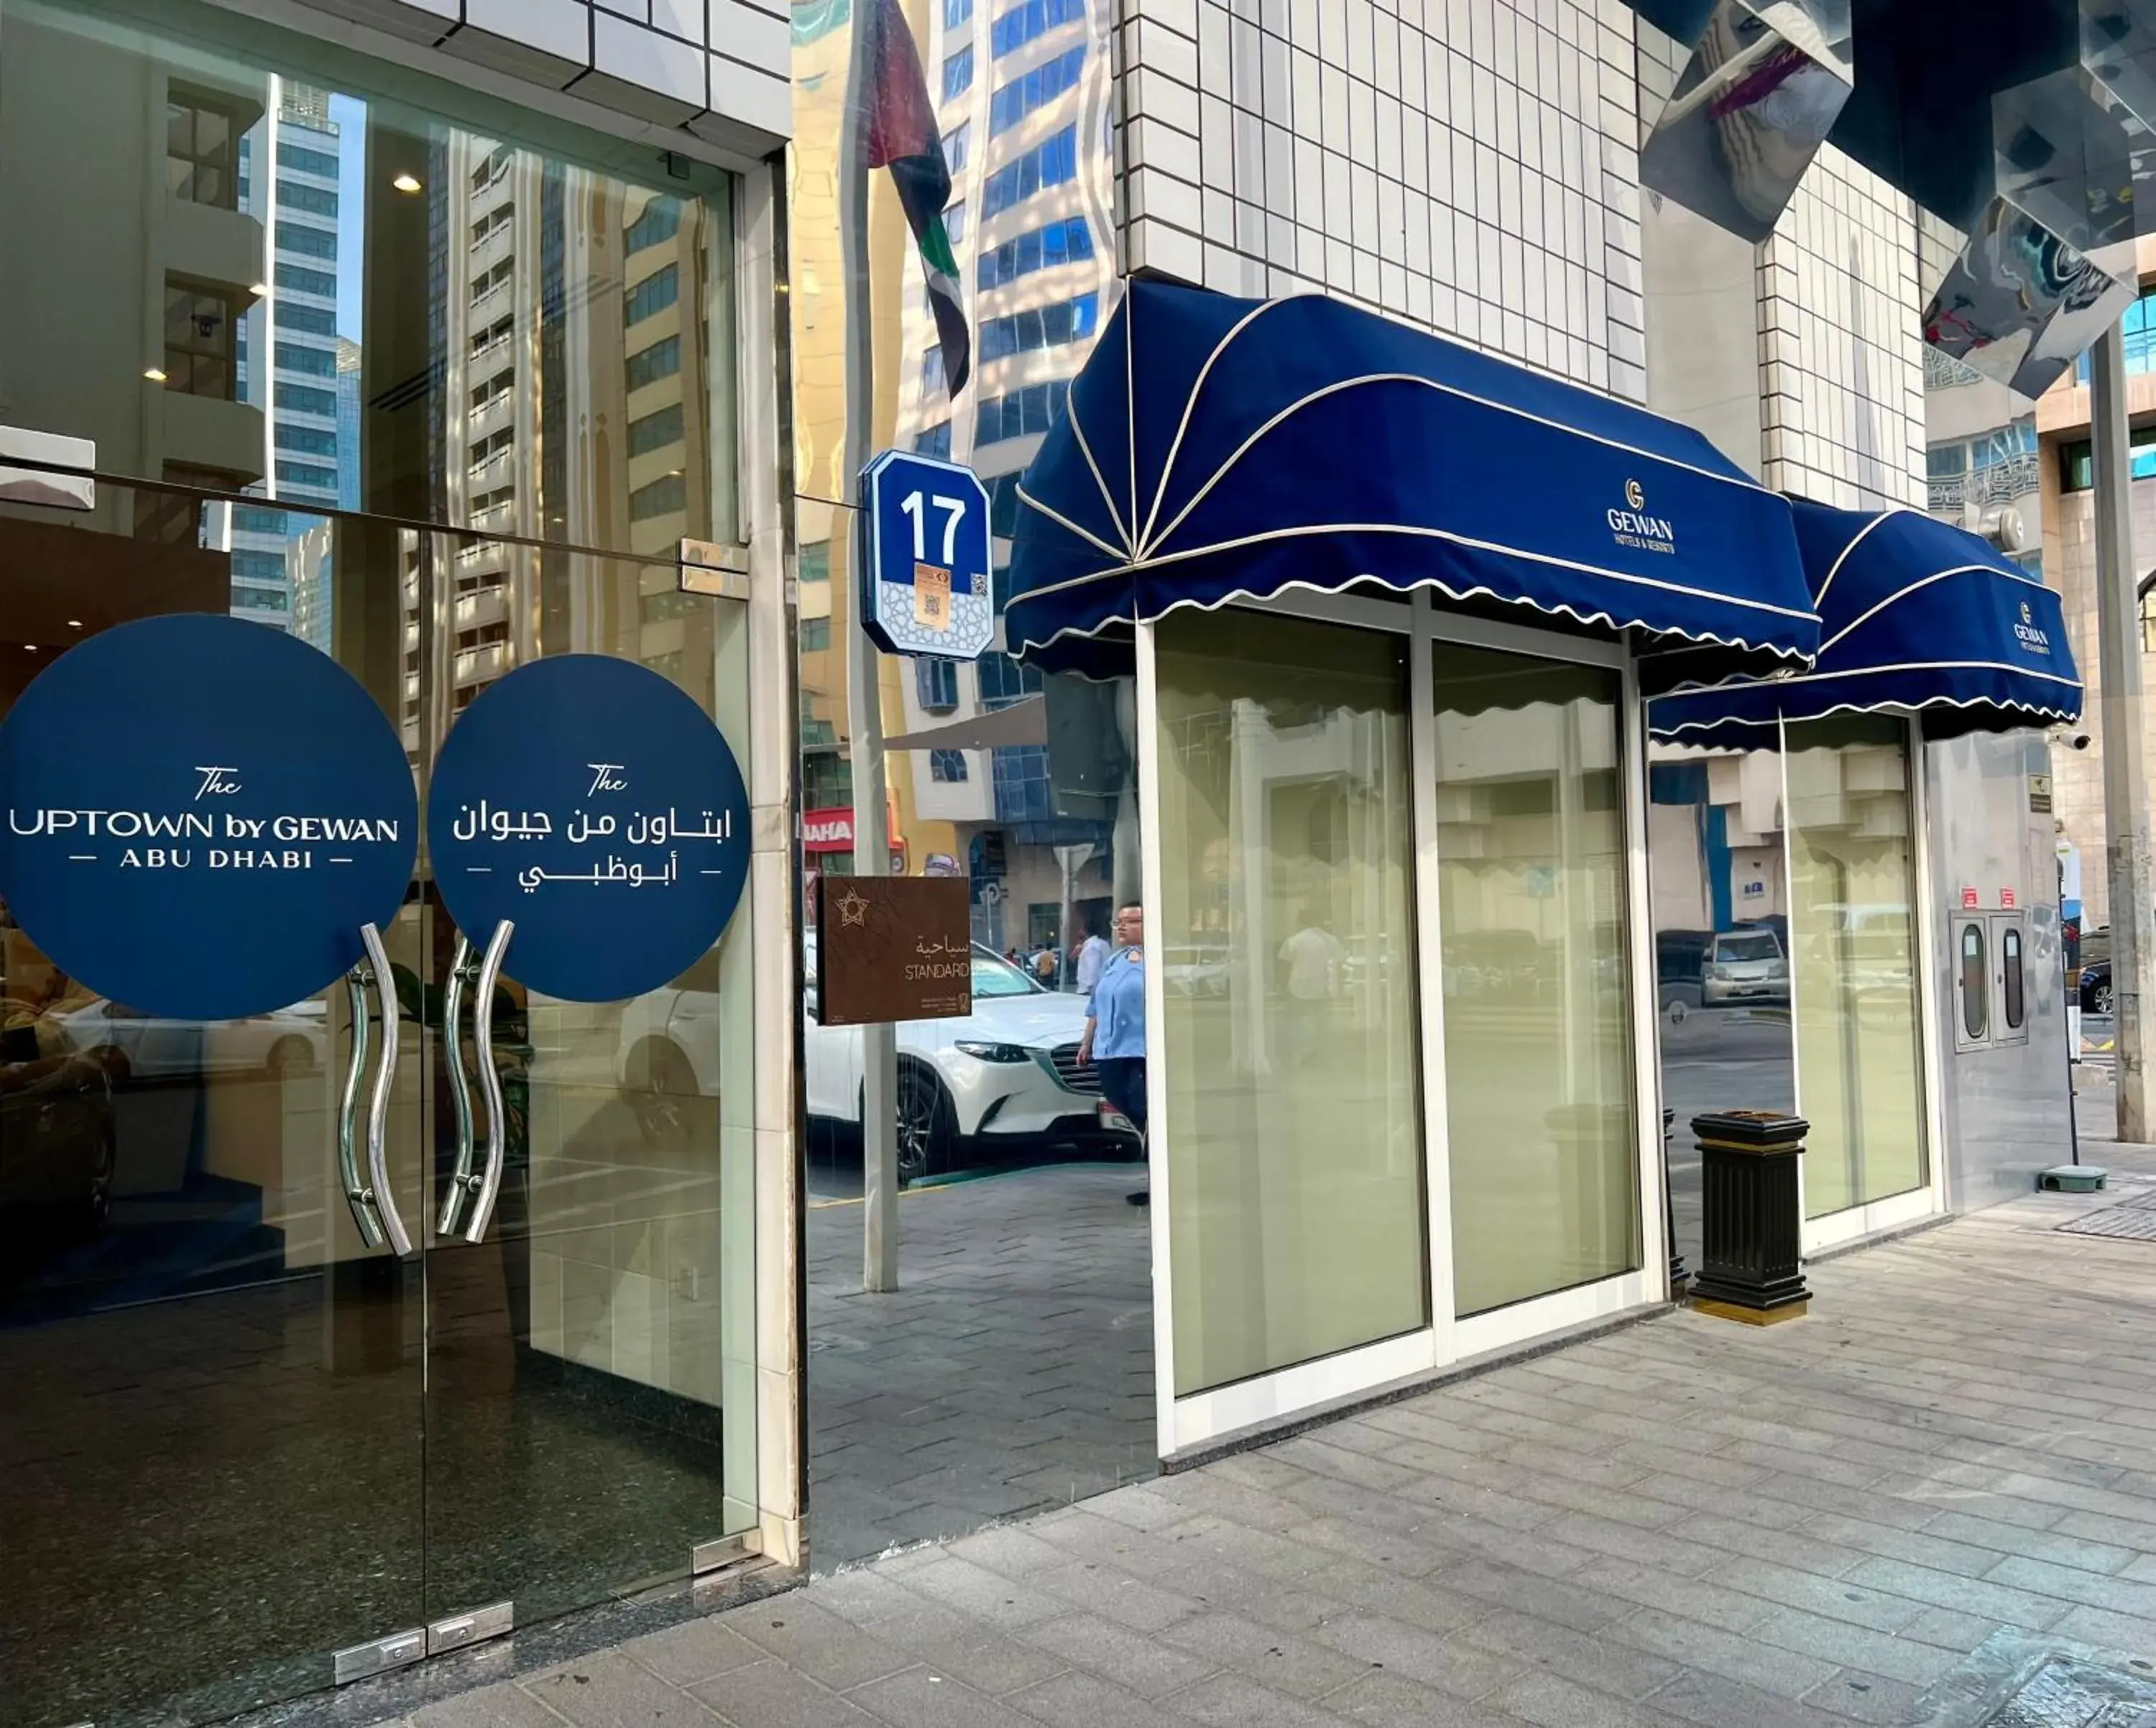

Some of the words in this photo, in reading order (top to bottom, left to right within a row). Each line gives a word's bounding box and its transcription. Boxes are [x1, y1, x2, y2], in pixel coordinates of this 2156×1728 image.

[900, 490, 967, 565] 17
[1607, 508, 1674, 541] GEWAN
[2014, 623, 2049, 645] GEWAN
[195, 766, 242, 801] The
[586, 763, 627, 797] The
[9, 809, 213, 838] UPTOWN
[226, 813, 267, 839] by
[272, 816, 398, 842] GEWAN
[453, 799, 553, 841] جيوان
[566, 809, 617, 843] من
[119, 849, 191, 868] ABU
[208, 850, 313, 868] DHABI
[517, 850, 678, 893] أبوظبي
[916, 934, 969, 960] سياحية
[905, 963, 969, 980] STANDARD
